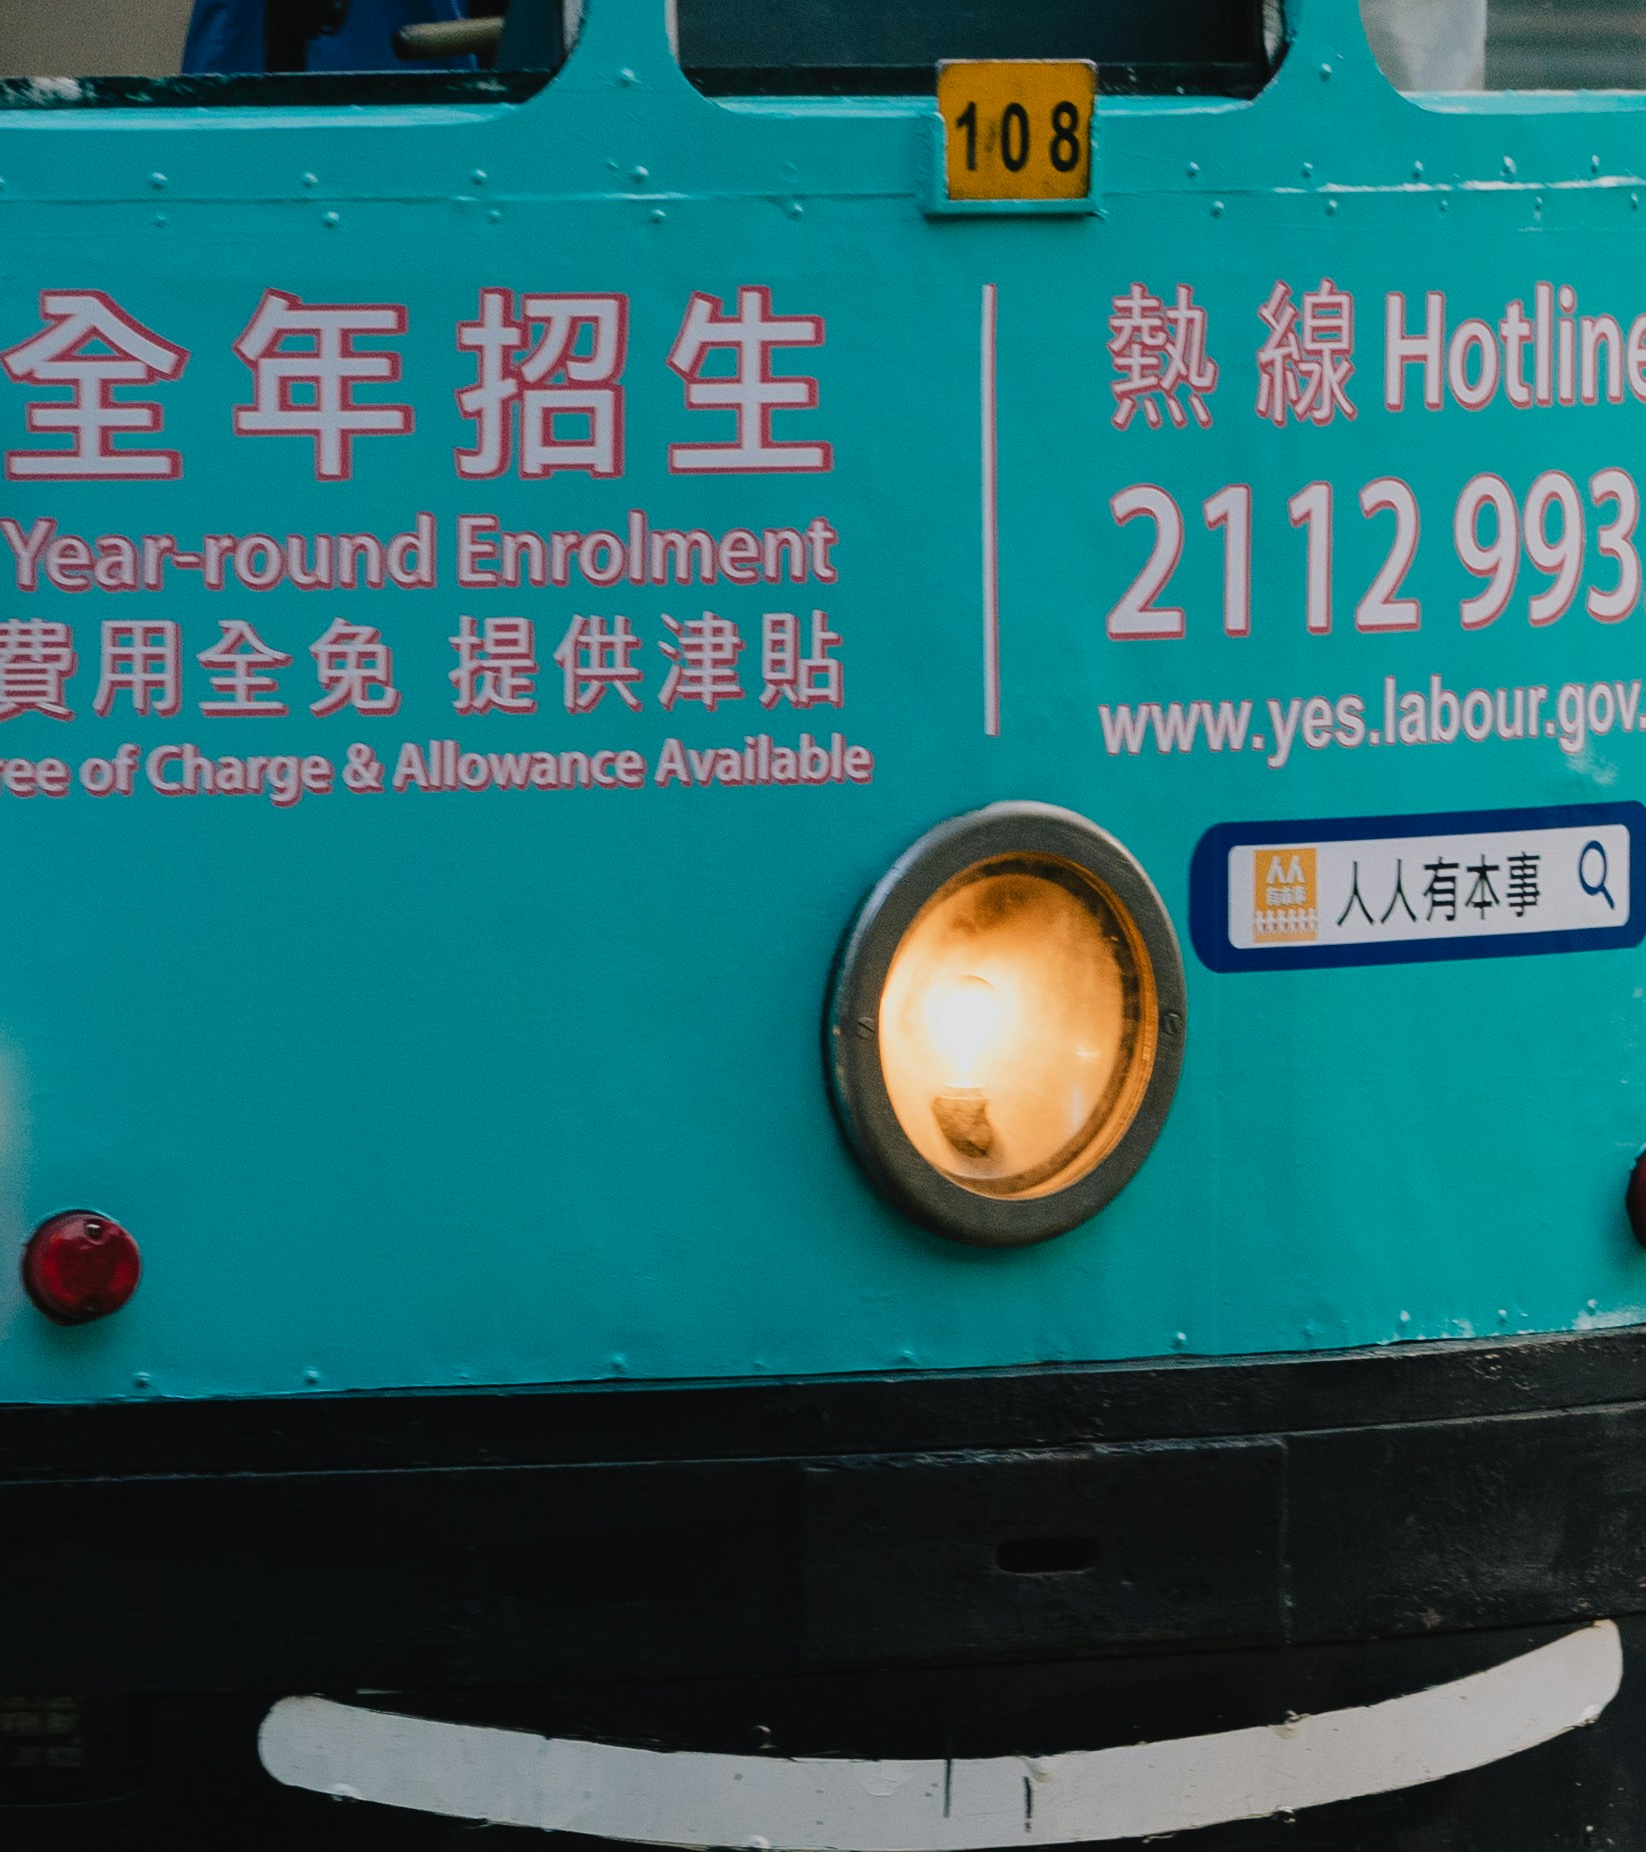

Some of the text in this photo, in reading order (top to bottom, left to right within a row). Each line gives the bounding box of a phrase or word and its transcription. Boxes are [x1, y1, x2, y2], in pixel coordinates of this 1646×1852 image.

[955, 100, 1080, 173] 108
[1105, 277, 1358, 431] 熱線
[456, 509, 839, 589] Enrolment
[1106, 476, 1422, 641] 2112
[448, 610, 844, 716] 提供津貼
[79, 743, 142, 797] of
[146, 743, 334, 808] Charge
[341, 743, 384, 794] &
[392, 738, 645, 793] Allowance
[653, 733, 874, 787] Available
[1336, 851, 1542, 926] 人人有本事
